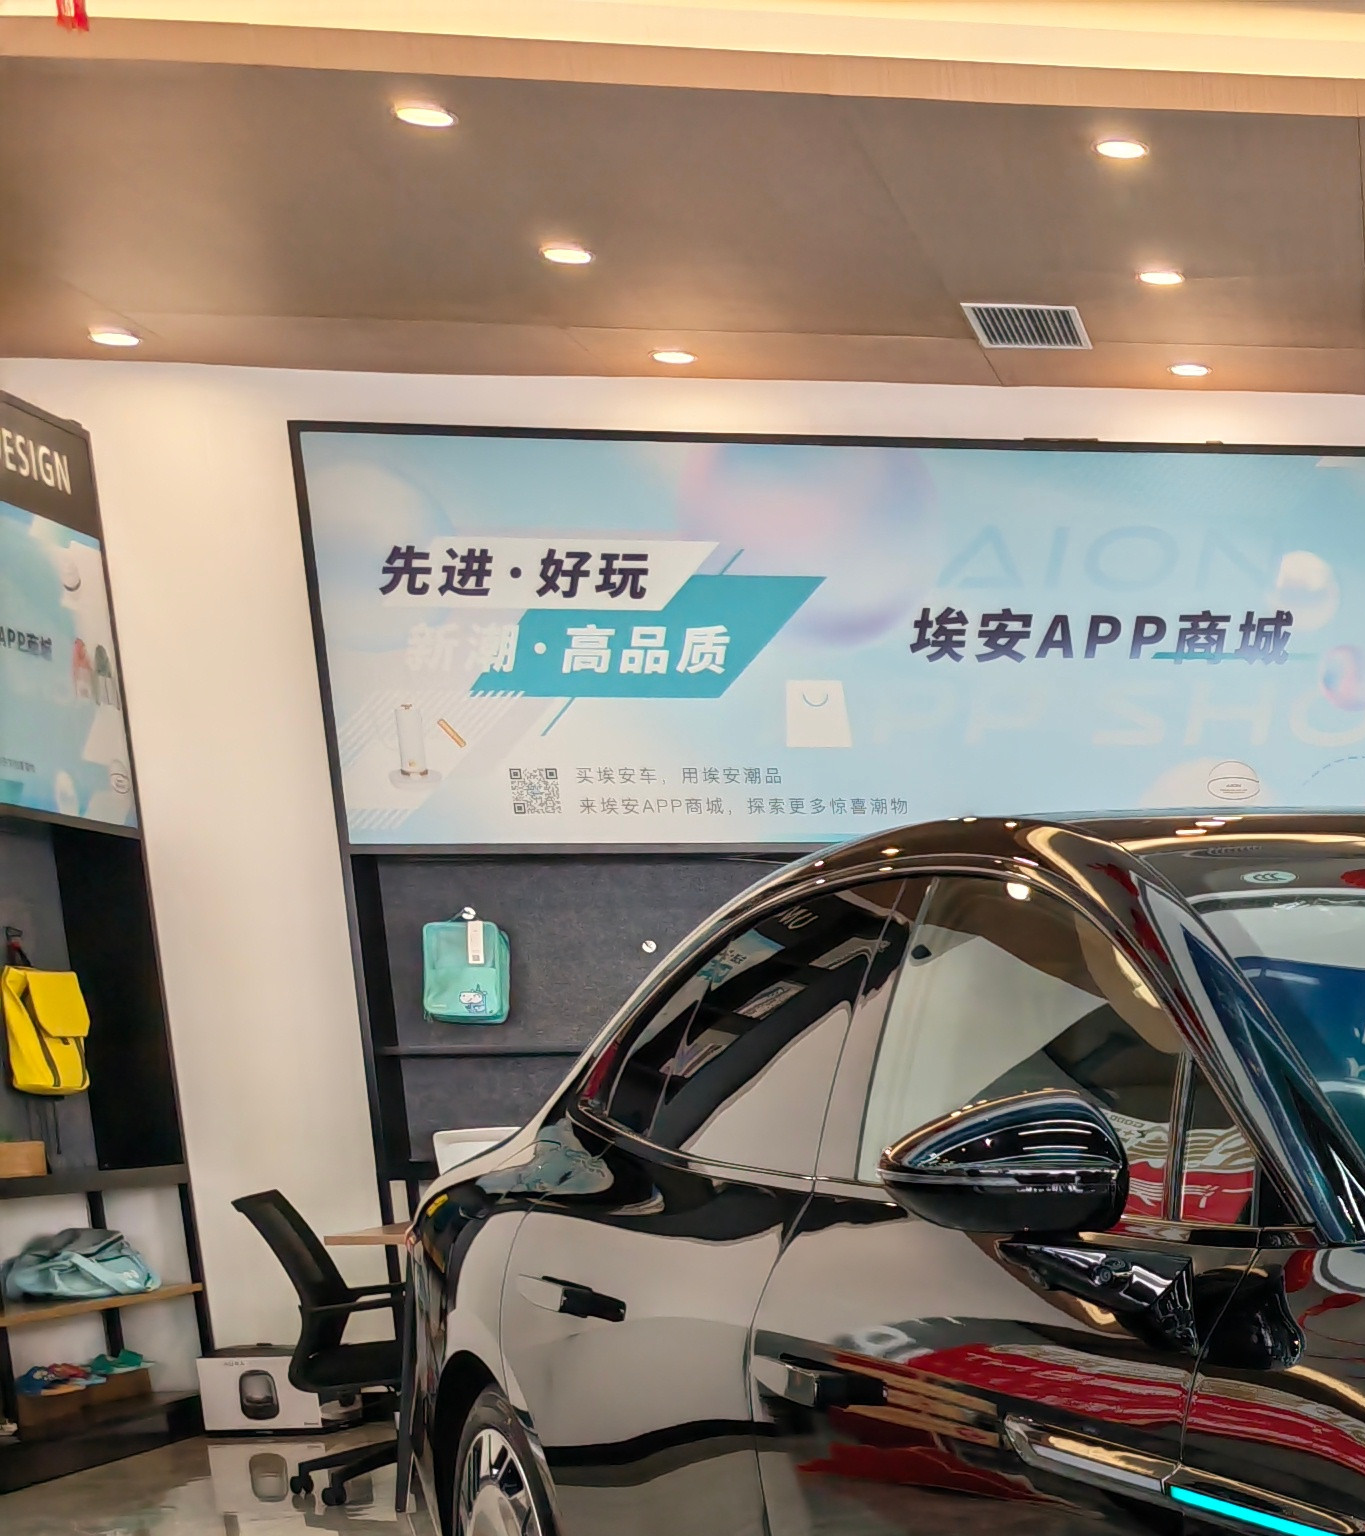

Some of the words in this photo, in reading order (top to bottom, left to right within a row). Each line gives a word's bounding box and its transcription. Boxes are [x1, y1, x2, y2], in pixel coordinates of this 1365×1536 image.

[0, 426, 72, 495] ESIGN
[908, 607, 1294, 665] 埃安APP商城
